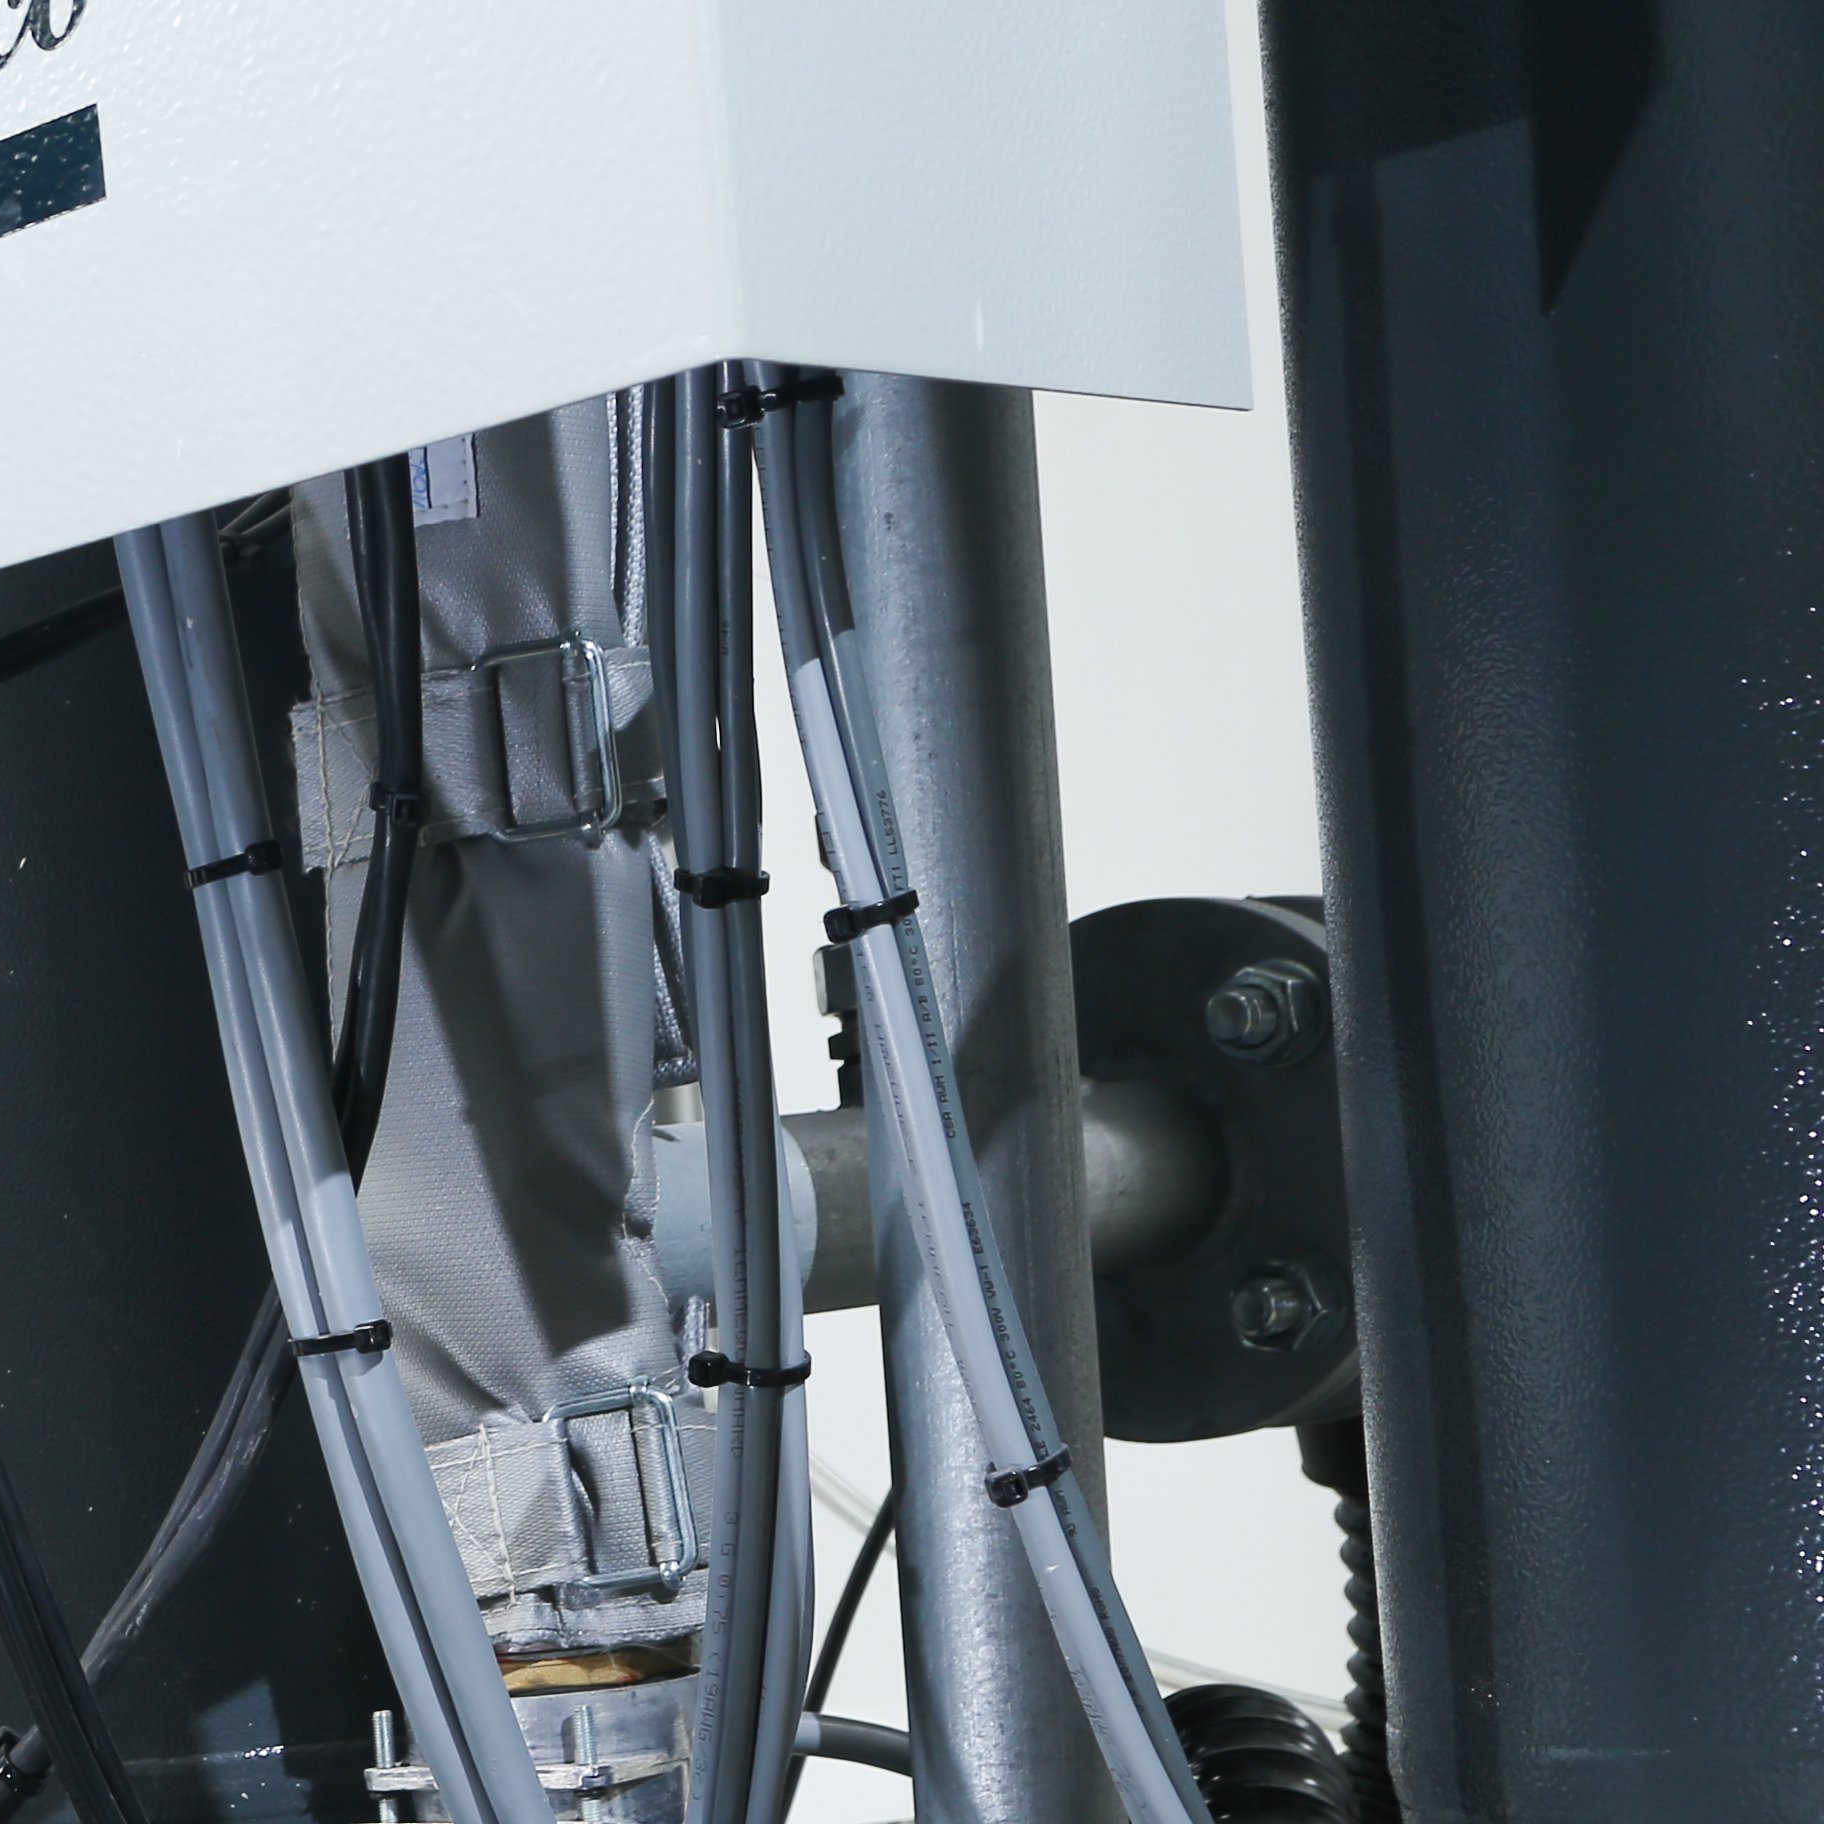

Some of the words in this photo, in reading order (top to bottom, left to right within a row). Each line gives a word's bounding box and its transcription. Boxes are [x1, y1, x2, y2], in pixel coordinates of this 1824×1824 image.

[877, 789, 898, 856] LL53776
[918, 995, 933, 1022] A/B
[935, 1075, 950, 1103] AWM
[943, 1111, 957, 1139] CSA
[962, 1201, 984, 1254] E63634
[992, 1307, 1010, 1342] 300V
[1023, 1397, 1042, 1432] 2464
